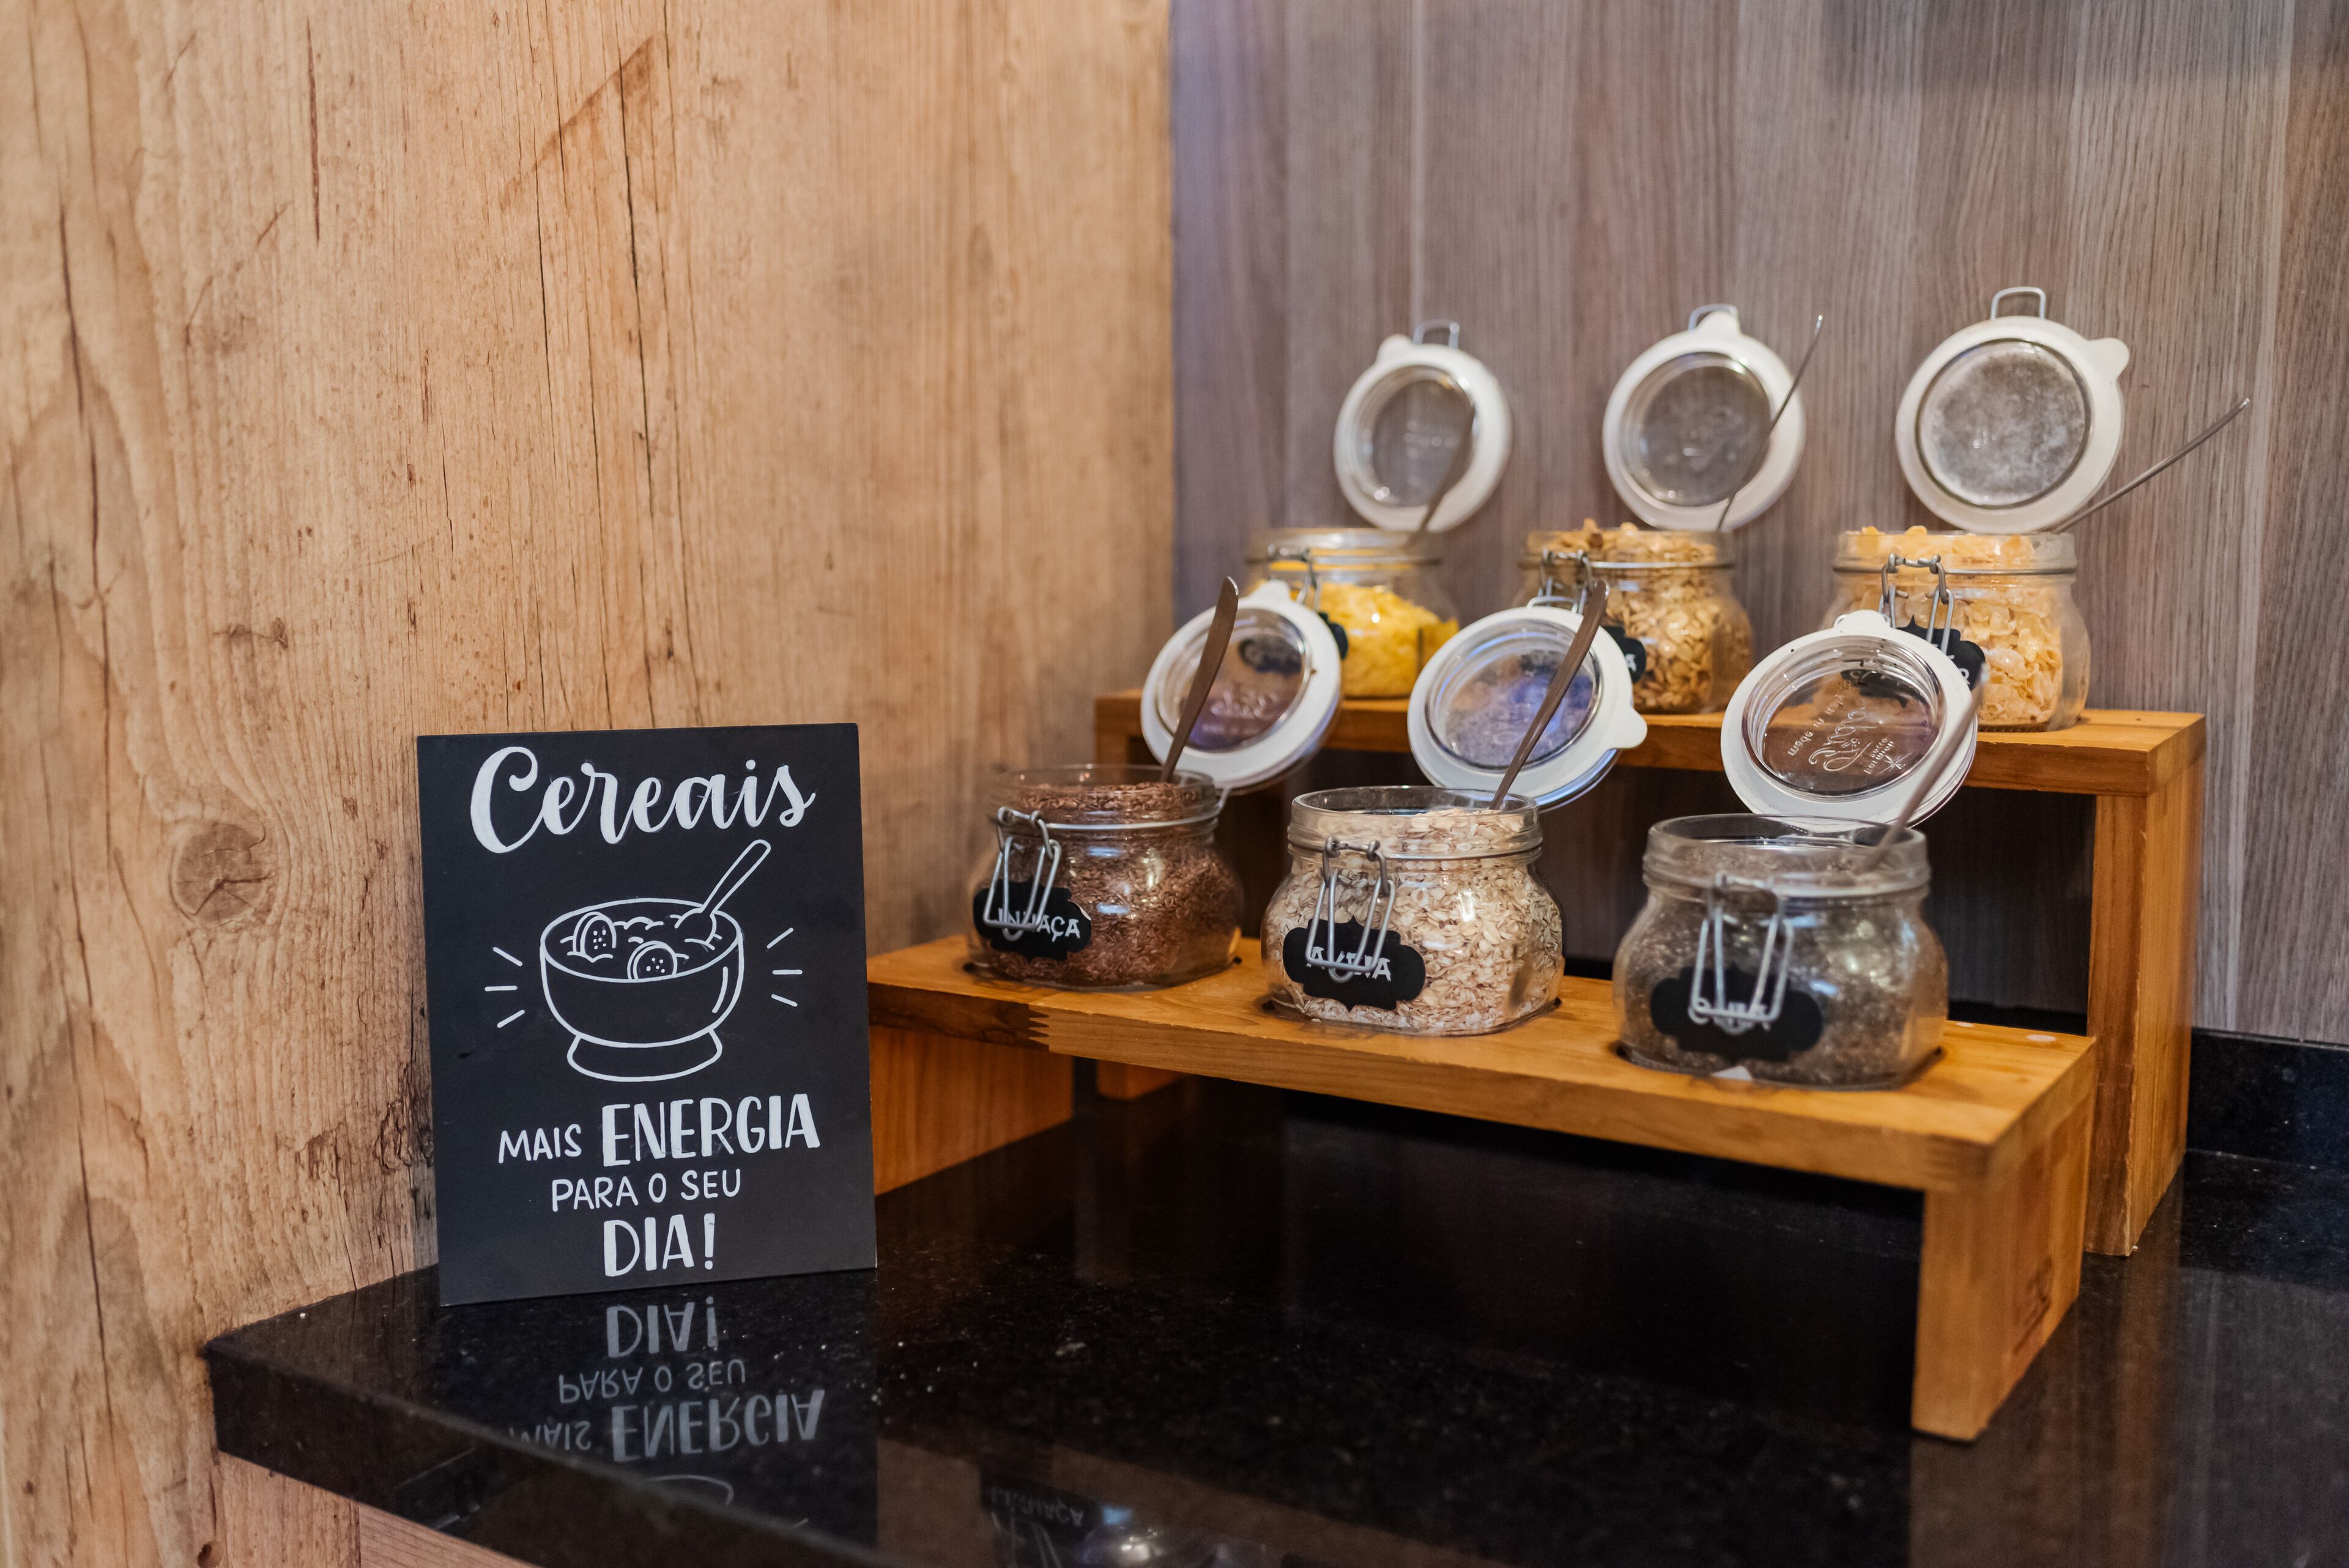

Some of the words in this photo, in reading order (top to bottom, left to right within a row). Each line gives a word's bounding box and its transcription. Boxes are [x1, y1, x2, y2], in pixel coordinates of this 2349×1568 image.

[470, 746, 816, 853] Cereais
[498, 1123, 582, 1164] MAIS
[602, 1093, 820, 1167] ENERGIA
[552, 1176, 639, 1213] PARA
[648, 1173, 667, 1203] O
[680, 1169, 741, 1200] SEU
[603, 1213, 715, 1277] DIA!
